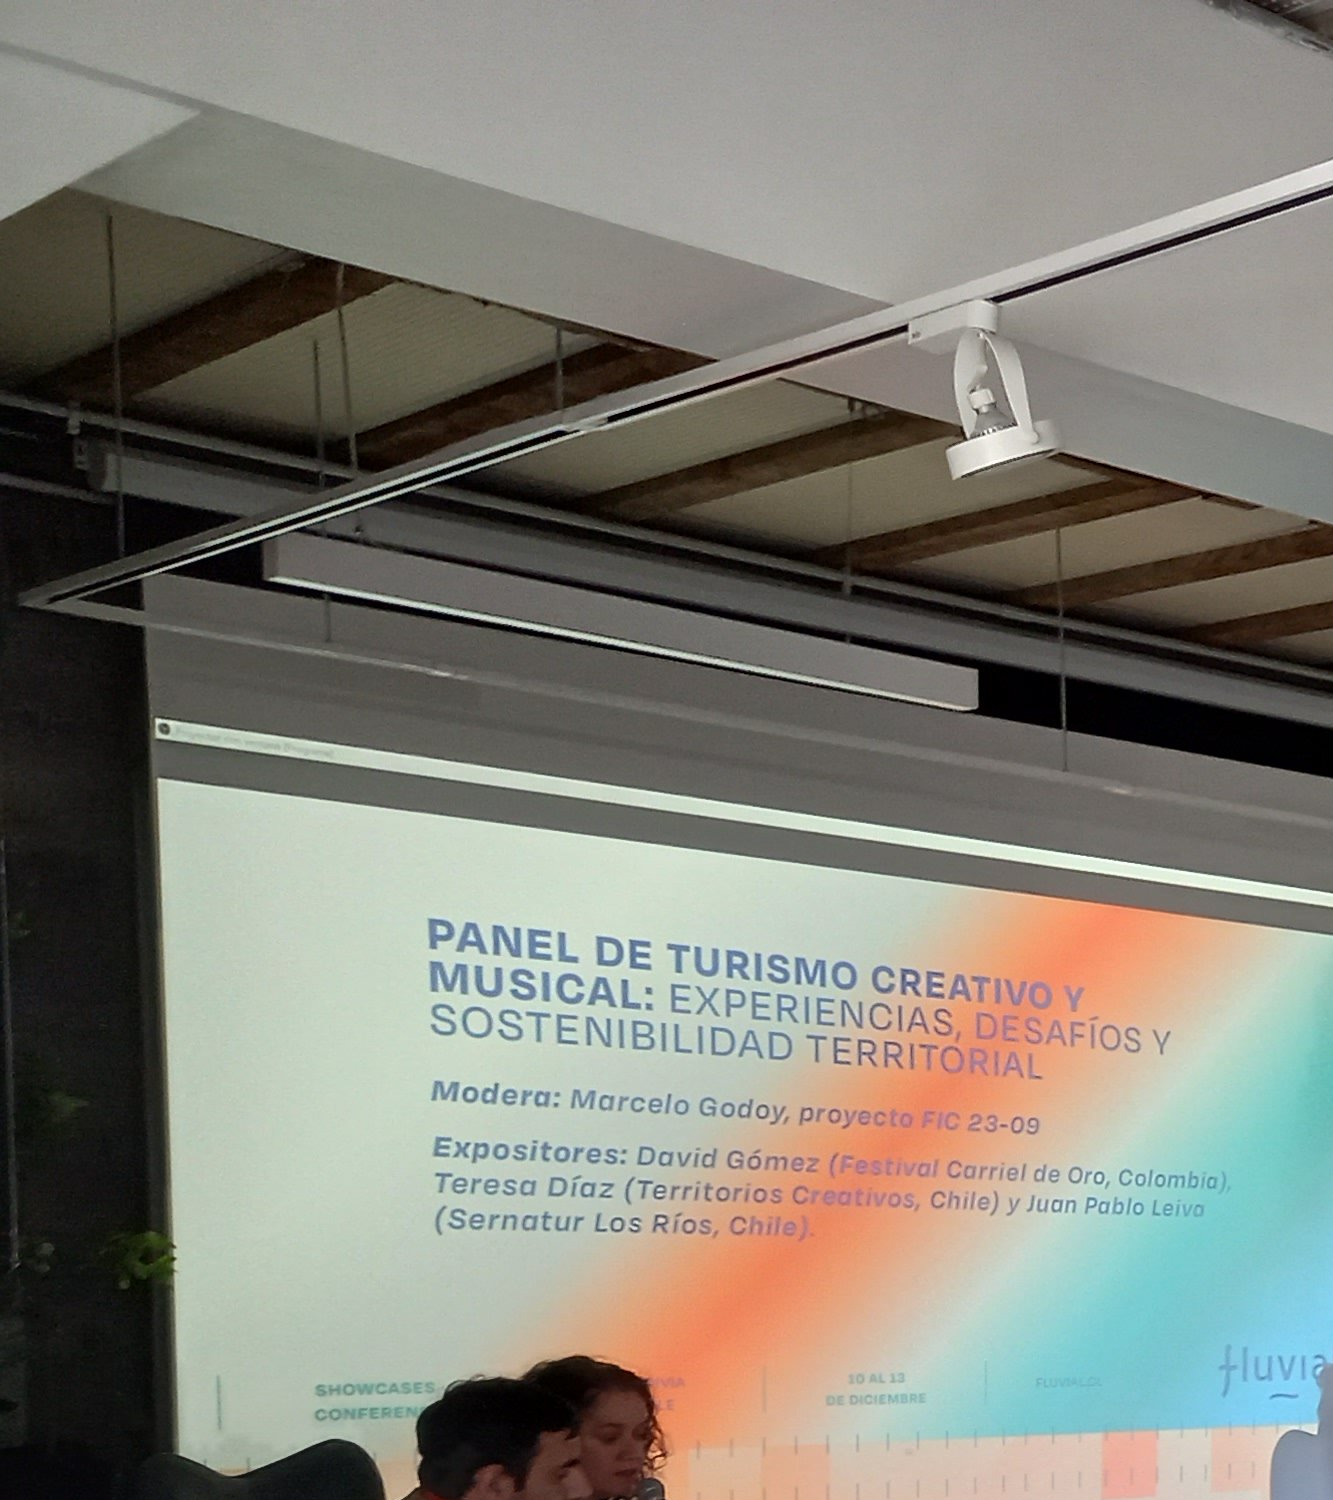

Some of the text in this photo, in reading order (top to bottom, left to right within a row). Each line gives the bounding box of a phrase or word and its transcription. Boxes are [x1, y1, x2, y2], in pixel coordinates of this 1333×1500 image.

[427, 917, 1085, 1013] PANEL DE TURISMO CREATIVO Y
[429, 961, 1172, 1055] MUSICAL: EXPERIENCIAS, DESAFÍOS Y
[430, 1003, 1043, 1081] SOSTENIBILIDAD TERRITORIAL
[431, 1080, 1040, 1136] Modera: Marcelo Godoy, proyecto FIC 23-09
[433, 1135, 1231, 1196] Expositores: David Gómez (Festival Carriel de Oro, Colombia),
[435, 1172, 1204, 1218] Teresa Díaz (Territorios Creativos, Chile) y Juan Pablo Leiva
[435, 1205, 814, 1243] (Sernatur Los Ríos, Chile).
[314, 1381, 436, 1398] SHOWCASES
[825, 1393, 927, 1406] DE DICIEMBRE
[847, 1372, 906, 1385] 10 AL 13
